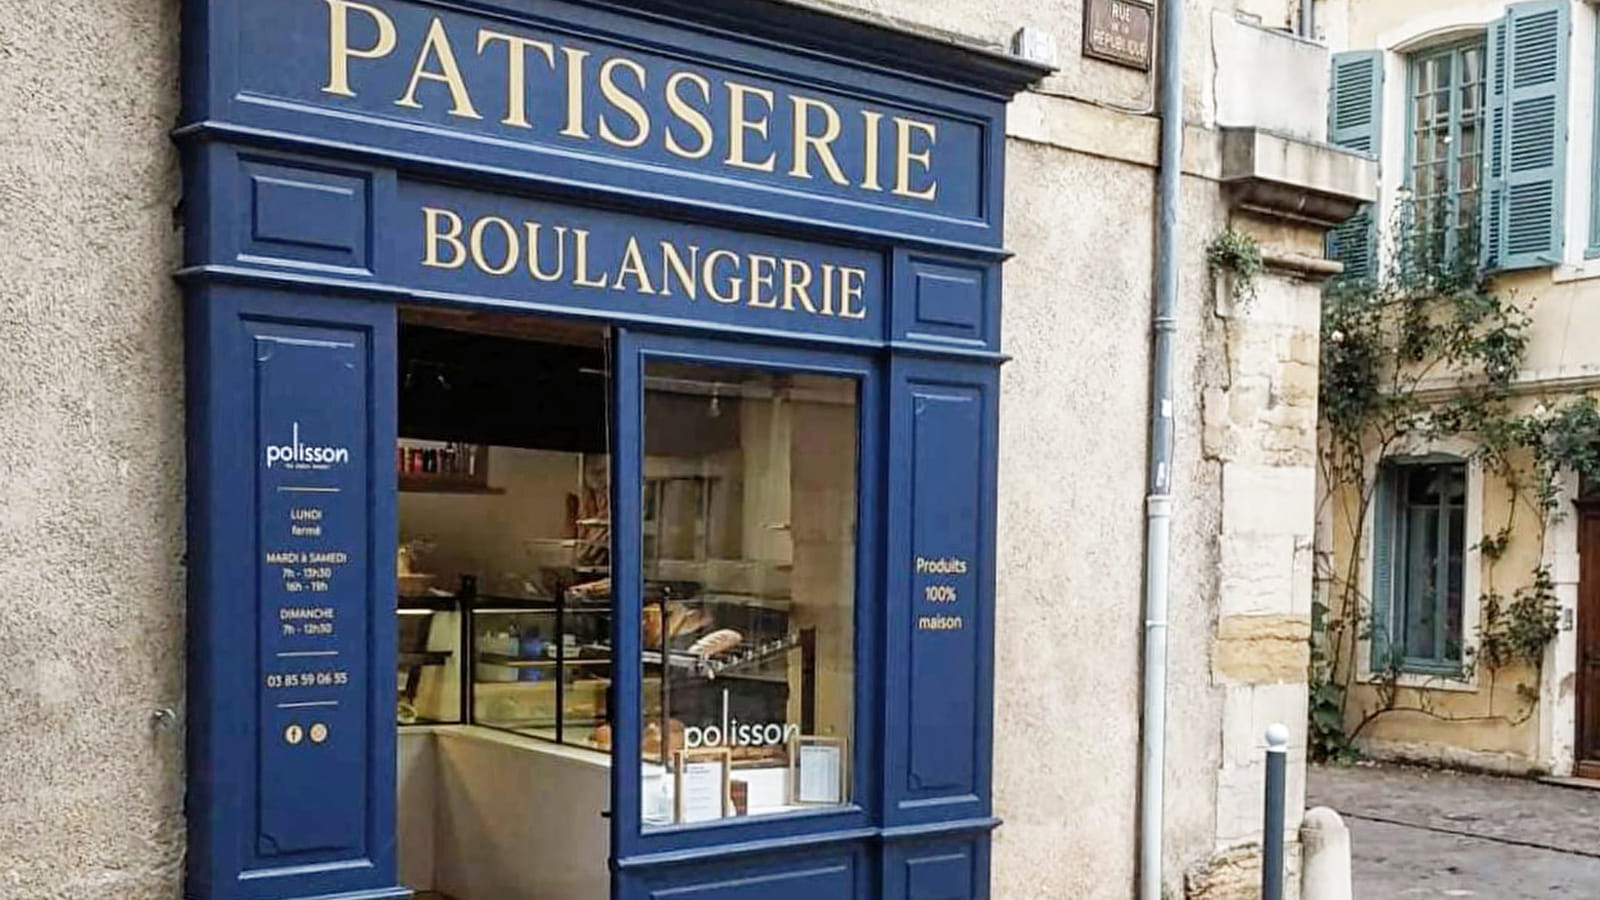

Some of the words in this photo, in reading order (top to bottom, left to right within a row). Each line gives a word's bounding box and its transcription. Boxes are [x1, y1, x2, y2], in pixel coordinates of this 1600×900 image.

[1112, 3, 1131, 22] RUE
[322, 0, 939, 202] PATISSERIE
[422, 206, 868, 320] BOULANGERIE
[266, 422, 349, 469] polisson
[290, 509, 322, 521] LUNDI
[266, 553, 299, 564] MARDI
[309, 553, 348, 564] SAMEDI
[916, 556, 968, 573] Produits
[925, 585, 957, 602] 100%
[279, 608, 335, 620] DIMANCHE
[918, 612, 963, 630] maison
[282, 624, 296, 637] 7h
[267, 675, 282, 688] 03
[284, 673, 299, 687] 85
[300, 673, 315, 687] 59
[684, 688, 802, 758] polisson
